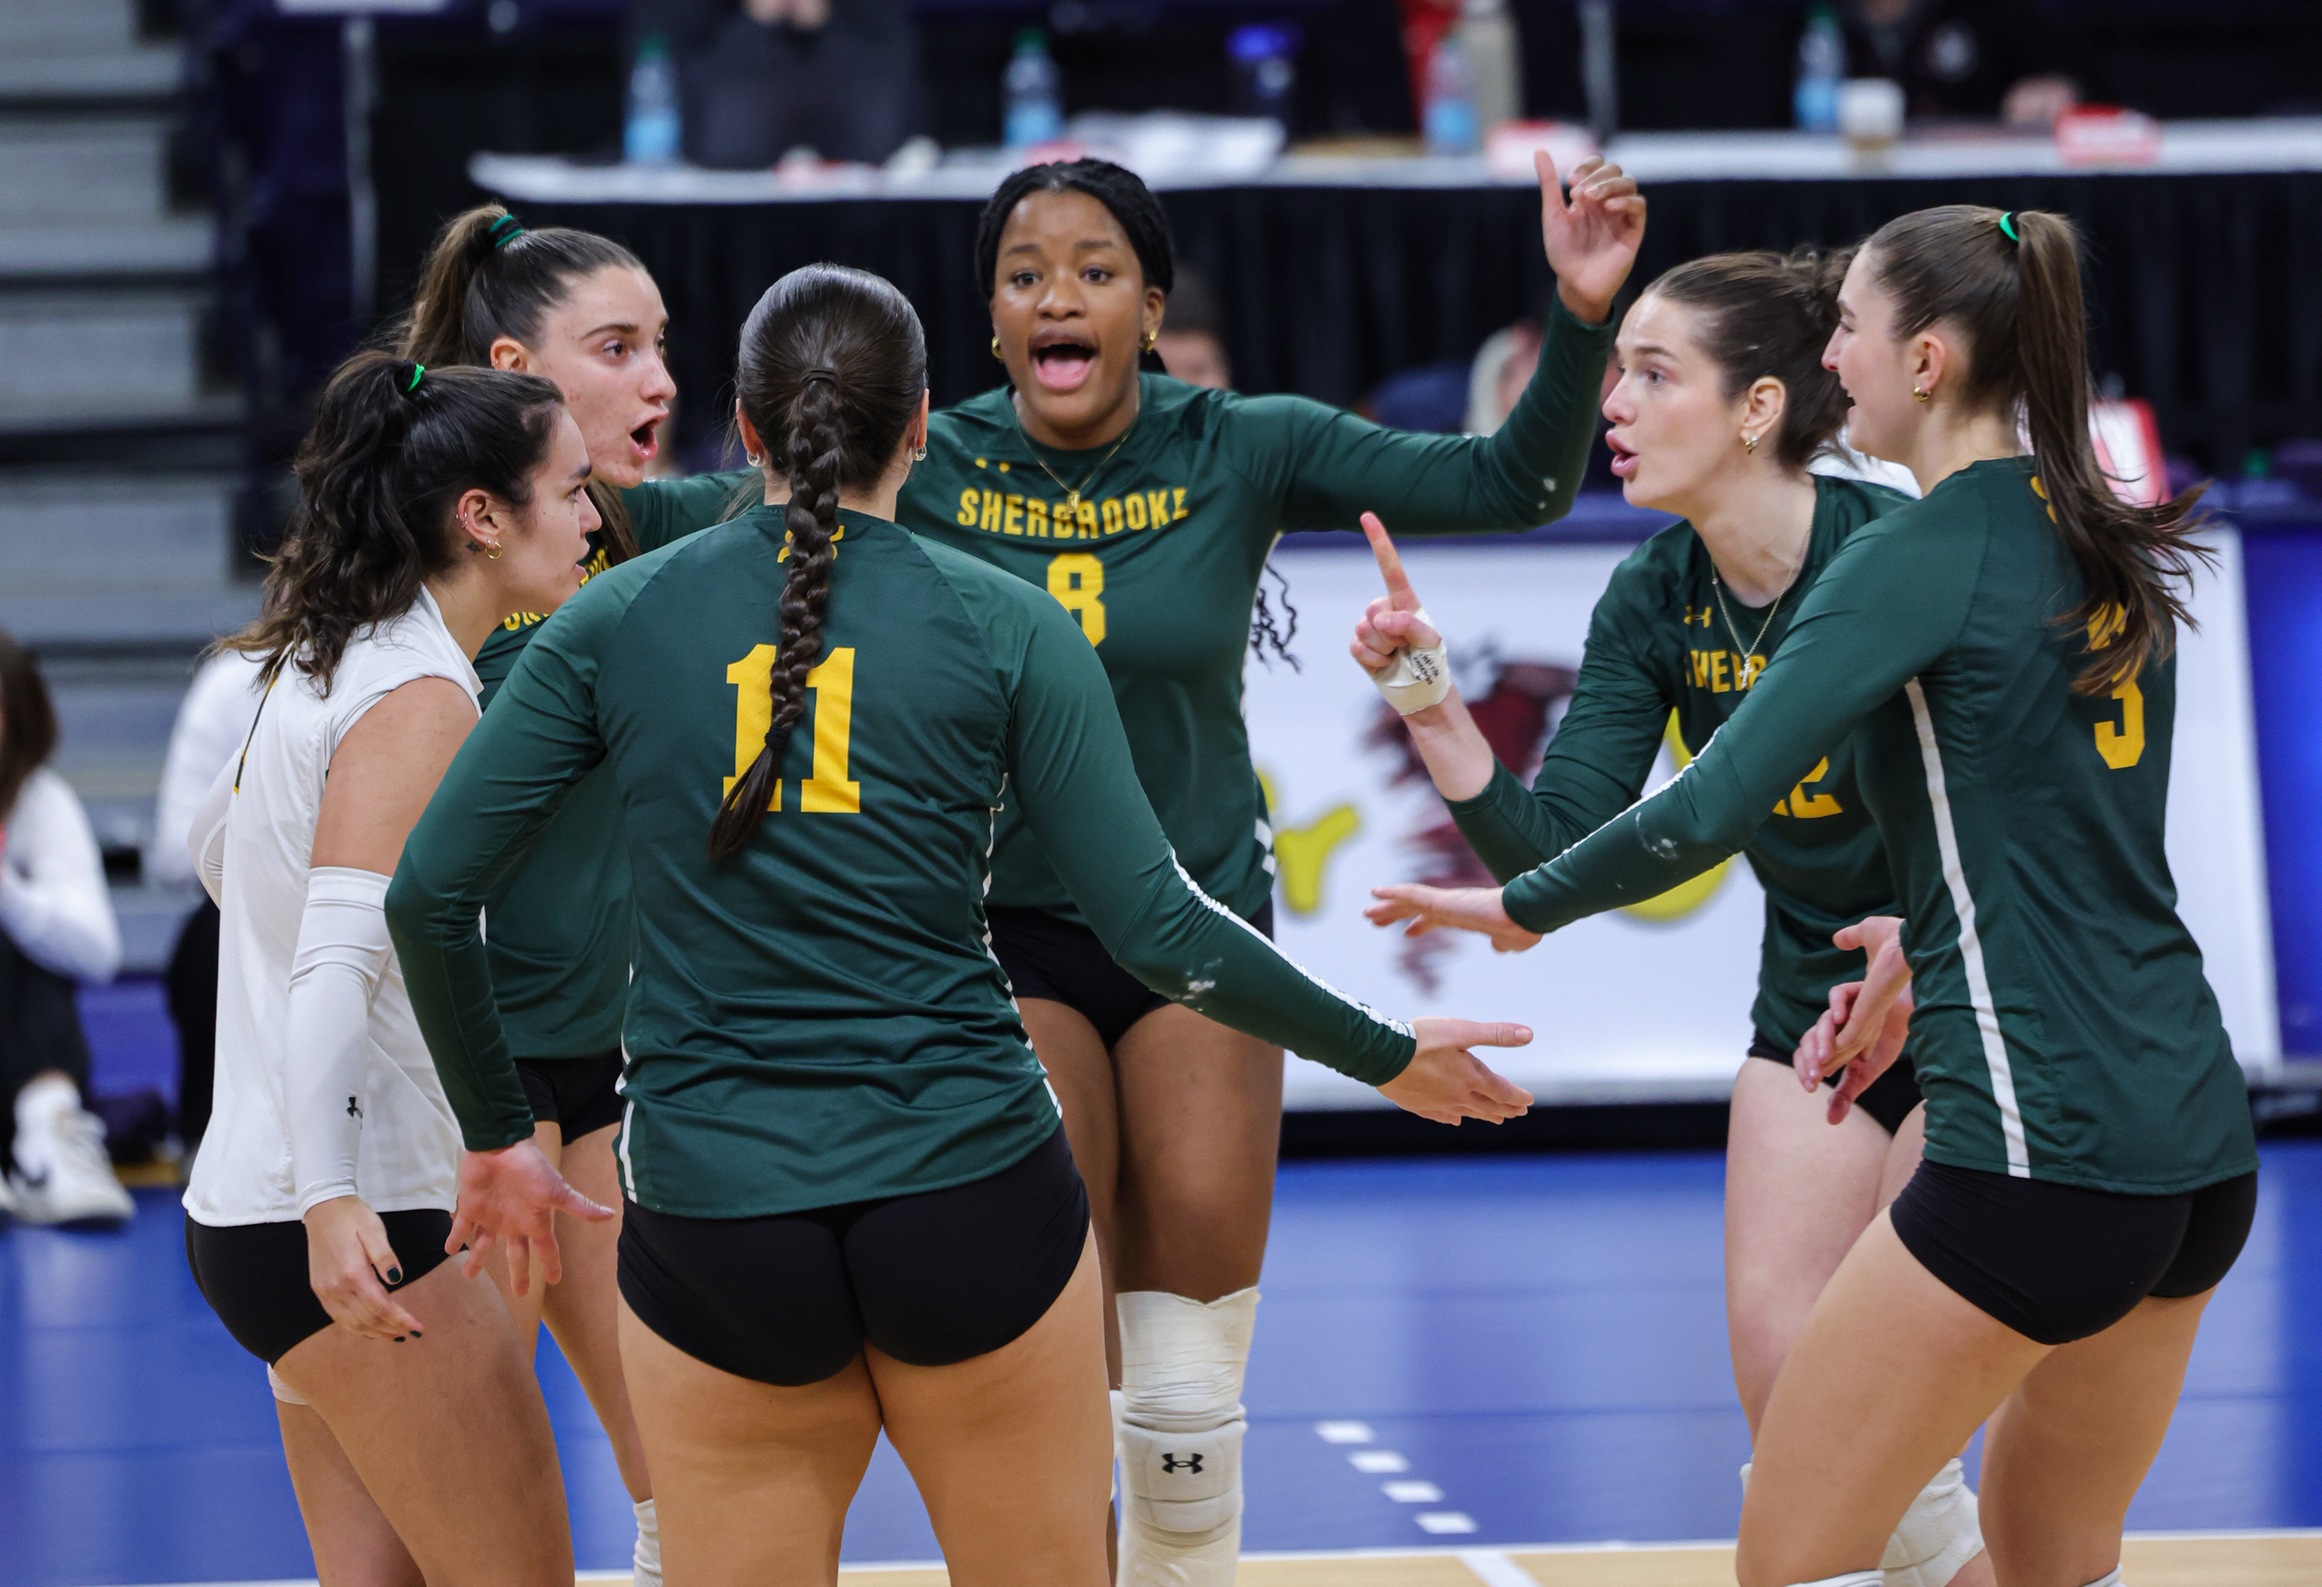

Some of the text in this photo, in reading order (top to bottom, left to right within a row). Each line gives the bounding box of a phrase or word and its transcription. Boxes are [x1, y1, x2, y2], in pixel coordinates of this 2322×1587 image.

[1047, 553, 1106, 648] 8
[723, 643, 861, 814] 11
[2087, 601, 2145, 770] 3
[1772, 755, 1844, 819] 2
